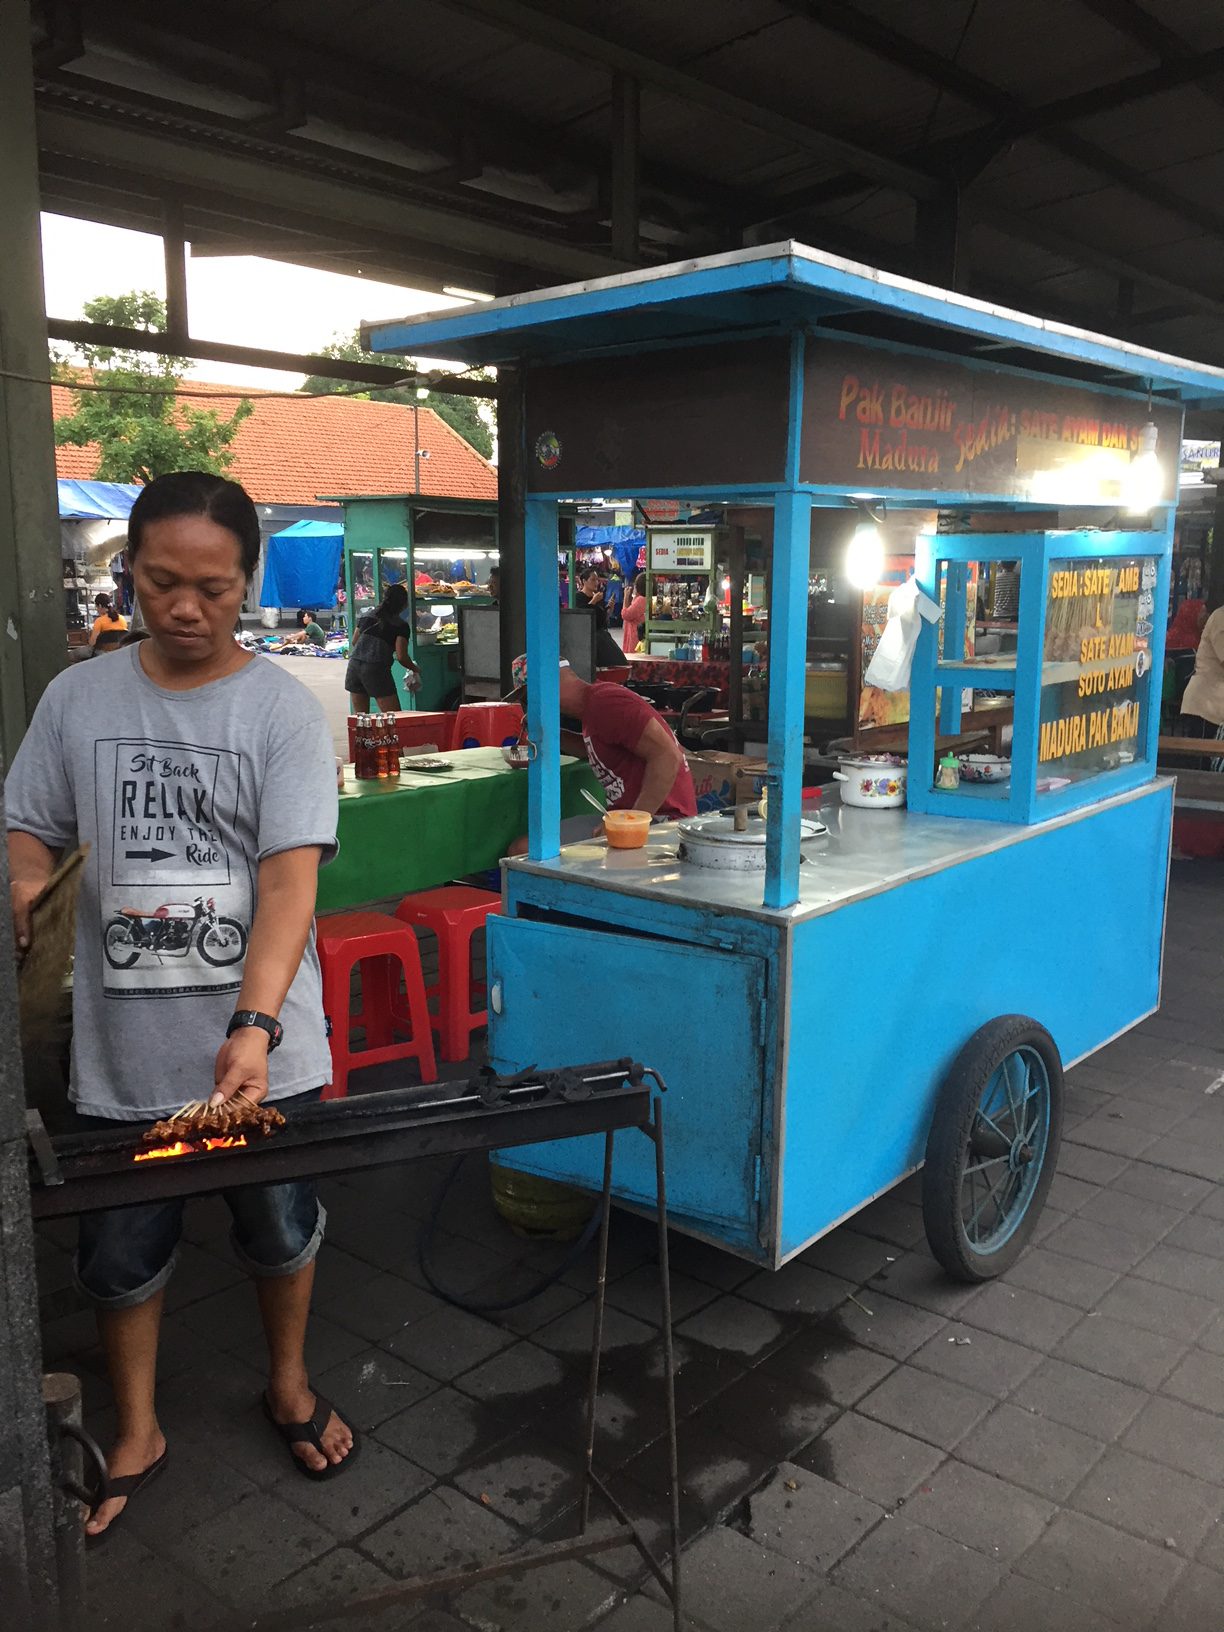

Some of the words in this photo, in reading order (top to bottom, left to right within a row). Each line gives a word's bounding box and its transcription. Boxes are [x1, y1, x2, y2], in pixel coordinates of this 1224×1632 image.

[838, 374, 885, 425] Pak
[889, 384, 957, 433] Banjir
[1020, 409, 1058, 441] SATE
[1062, 415, 1099, 446] AYAM
[1102, 421, 1127, 449] DAN
[857, 427, 939, 473] Madura
[1084, 569, 1110, 596] SATE
[1081, 636, 1105, 662] SATE
[1109, 632, 1134, 657] AYAM
[1078, 670, 1105, 697] SOTO
[1107, 663, 1133, 691] AYAM
[1040, 714, 1086, 762] MADURA
[1089, 708, 1110, 749] PAK
[130, 753, 158, 773] Sit
[159, 757, 201, 783] Back
[121, 780, 210, 823] RELAX
[121, 826, 175, 840] ENJOY
[187, 828, 217, 842] THE
[186, 844, 220, 866] Ride
